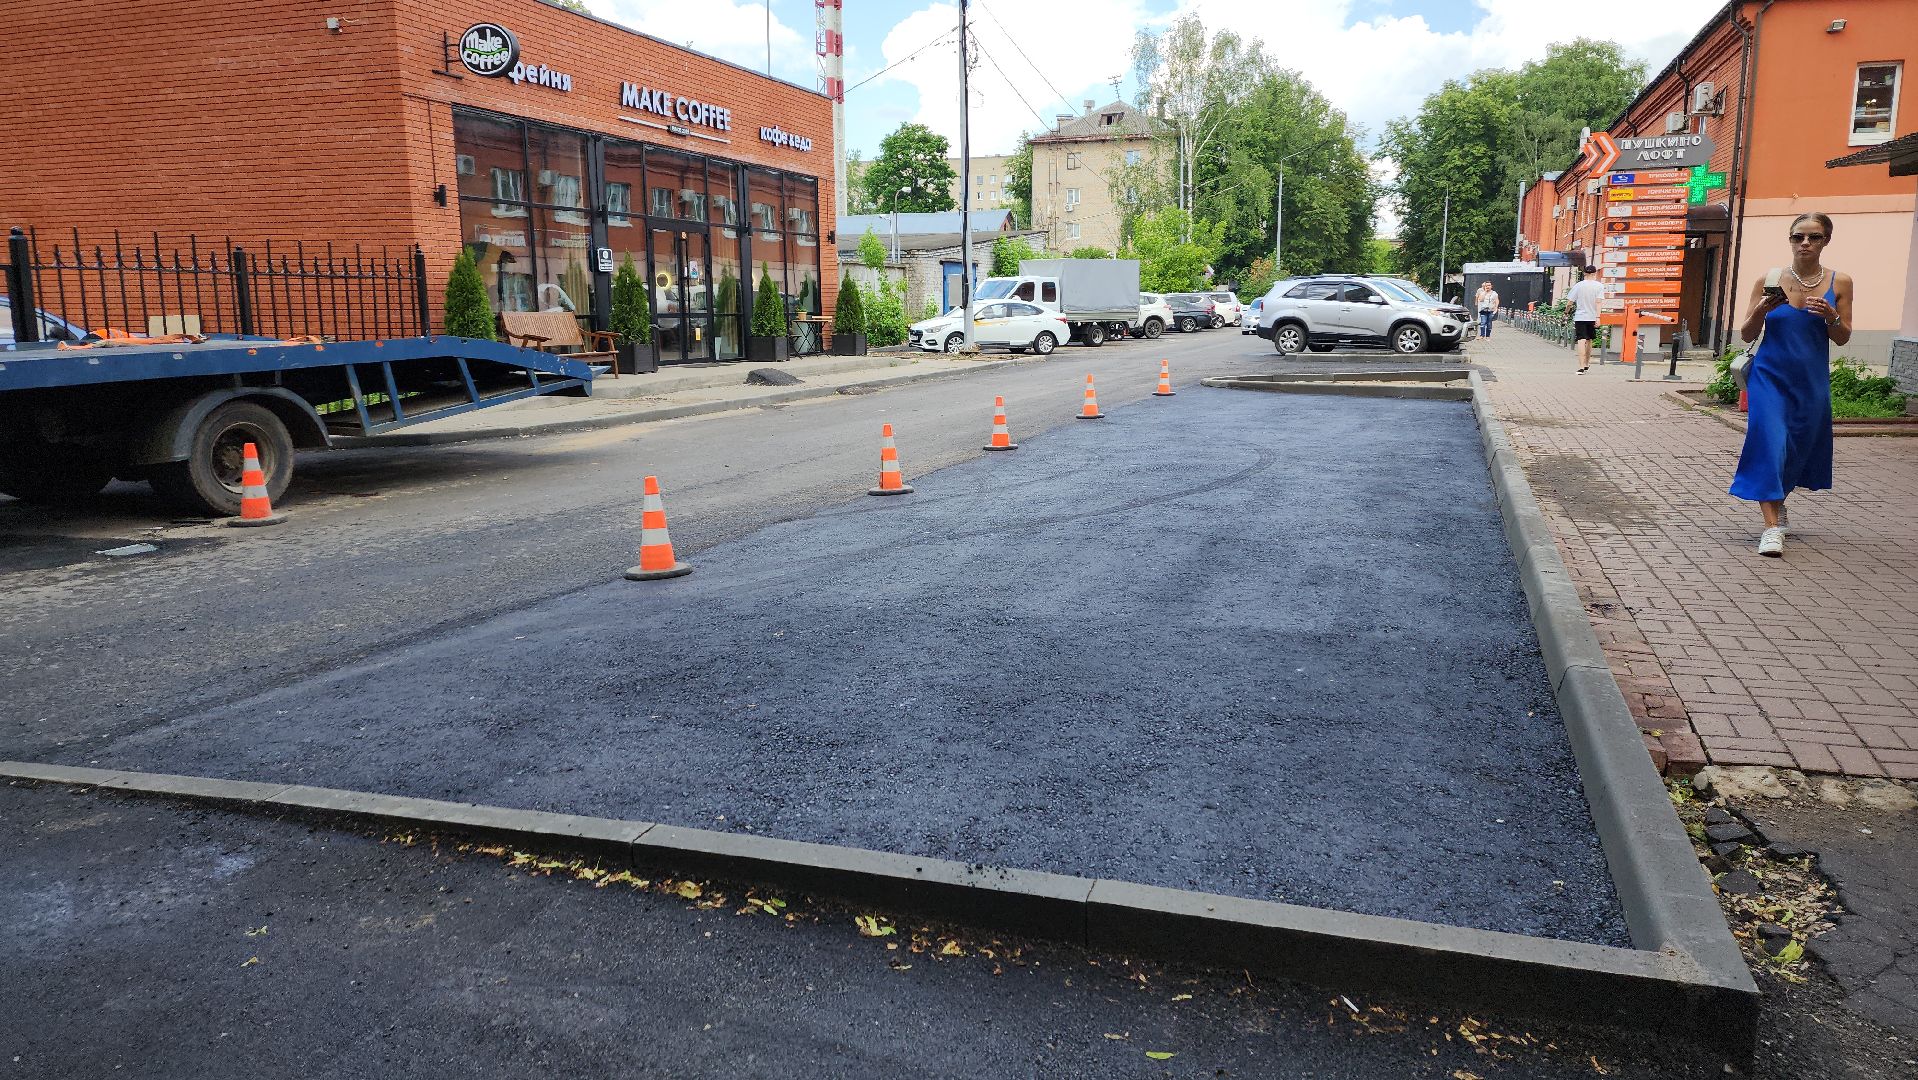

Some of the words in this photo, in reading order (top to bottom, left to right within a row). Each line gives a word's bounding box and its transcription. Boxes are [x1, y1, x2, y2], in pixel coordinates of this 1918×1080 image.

[623, 81, 672, 118] MAKE
[676, 96, 732, 132] COFFEE
[760, 125, 787, 147] кофе
[795, 134, 812, 152] еда
[1621, 136, 1702, 150] ПУШКИНО
[1637, 148, 1686, 161] ЛОФТ
